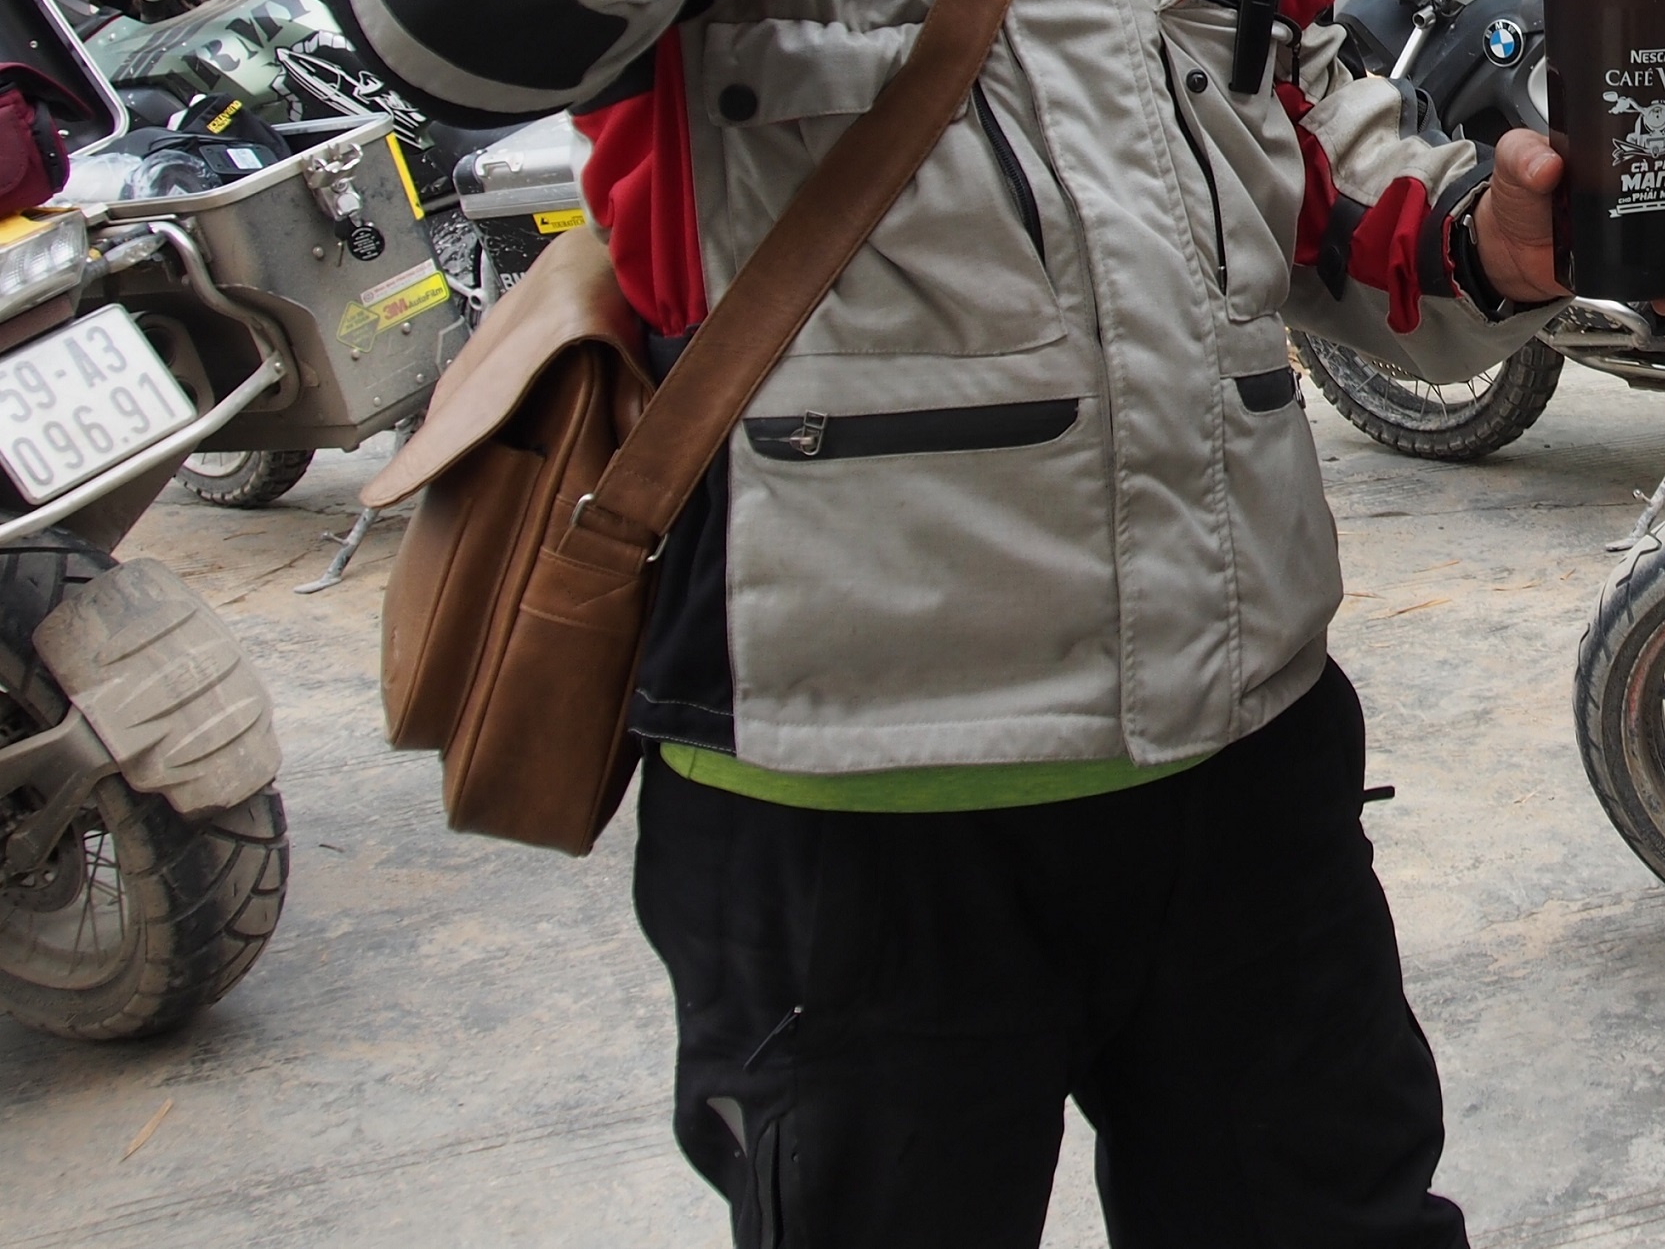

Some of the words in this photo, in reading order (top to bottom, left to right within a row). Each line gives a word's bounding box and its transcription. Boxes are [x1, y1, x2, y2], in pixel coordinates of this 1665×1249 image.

[1631, 158, 1649, 173] CÀ
[382, 297, 409, 320] 3M
[0, 325, 128, 423] 59-A3
[12, 371, 177, 486] 096.91
